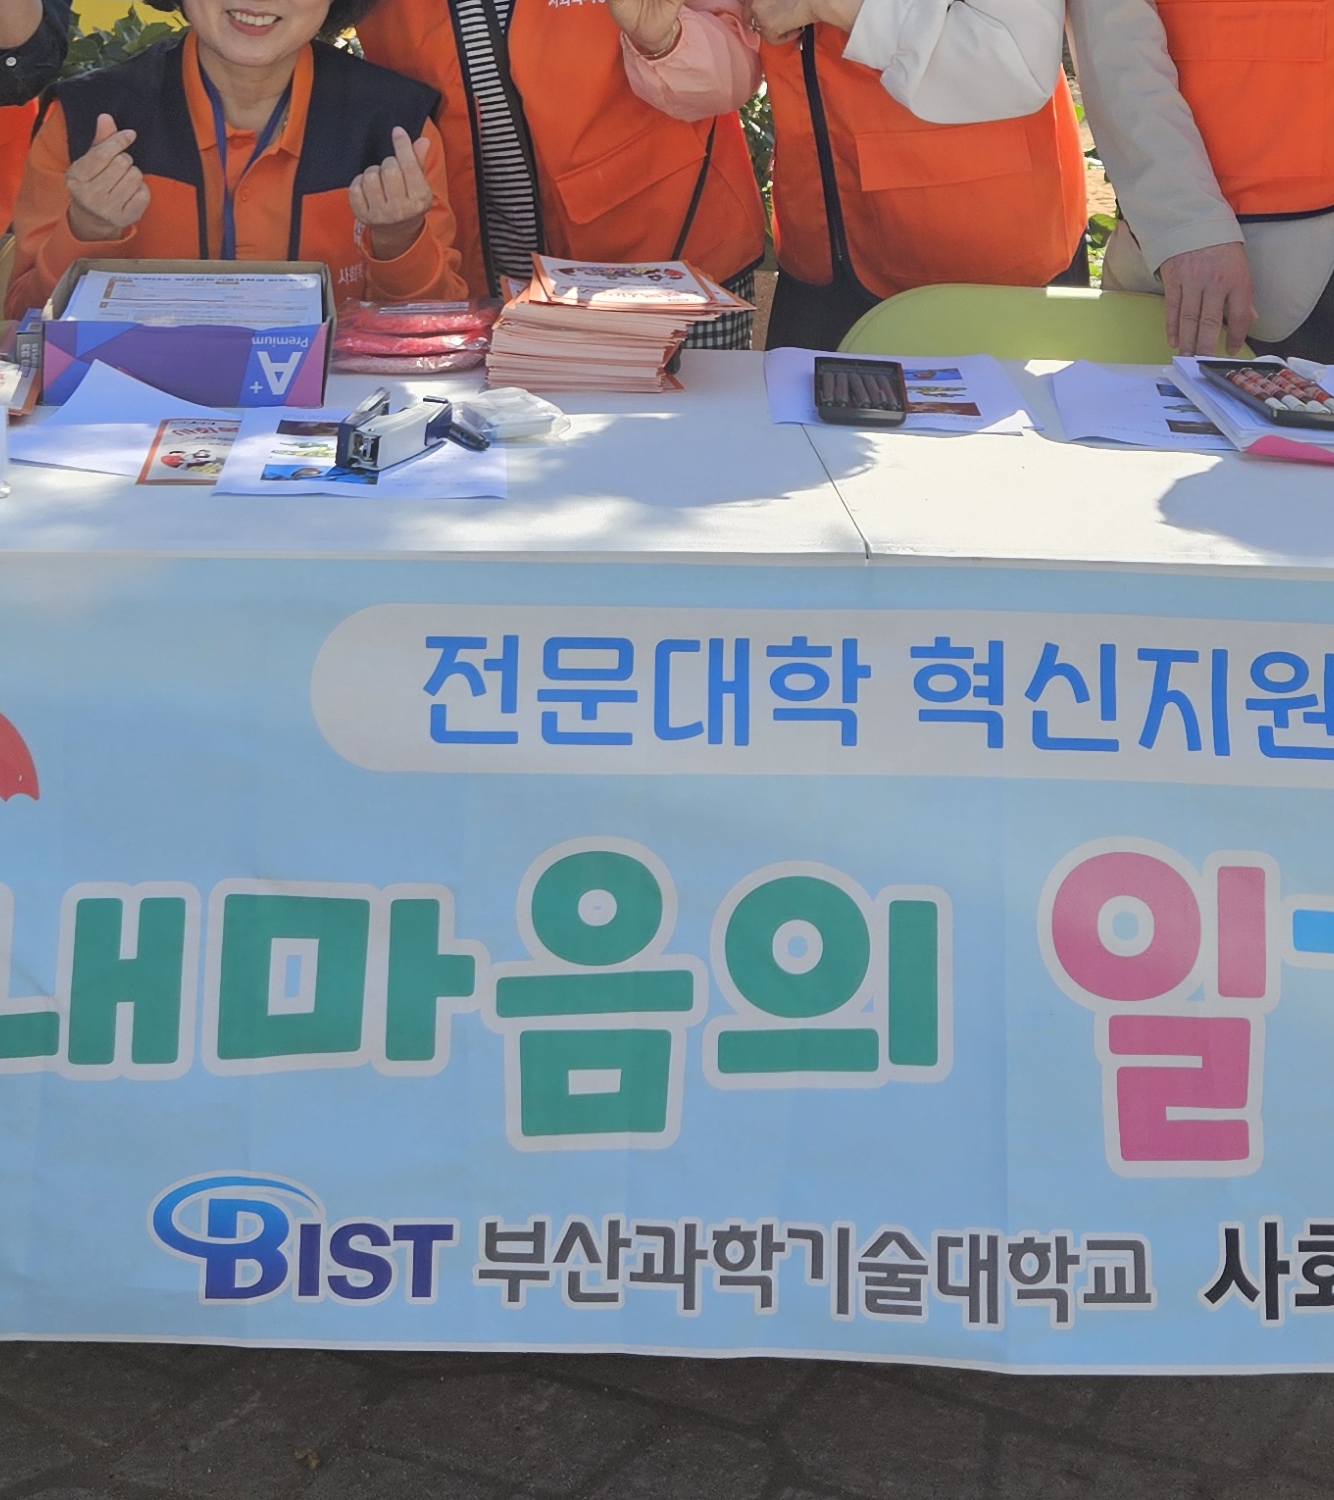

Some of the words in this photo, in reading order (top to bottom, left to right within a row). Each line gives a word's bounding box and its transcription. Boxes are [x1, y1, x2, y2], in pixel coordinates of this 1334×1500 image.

[252, 335, 309, 348] Premium
[423, 635, 871, 747] 전문대학
[153, 1175, 454, 1300] BIST
[478, 1217, 1153, 1327] 부산과학기술대학교
